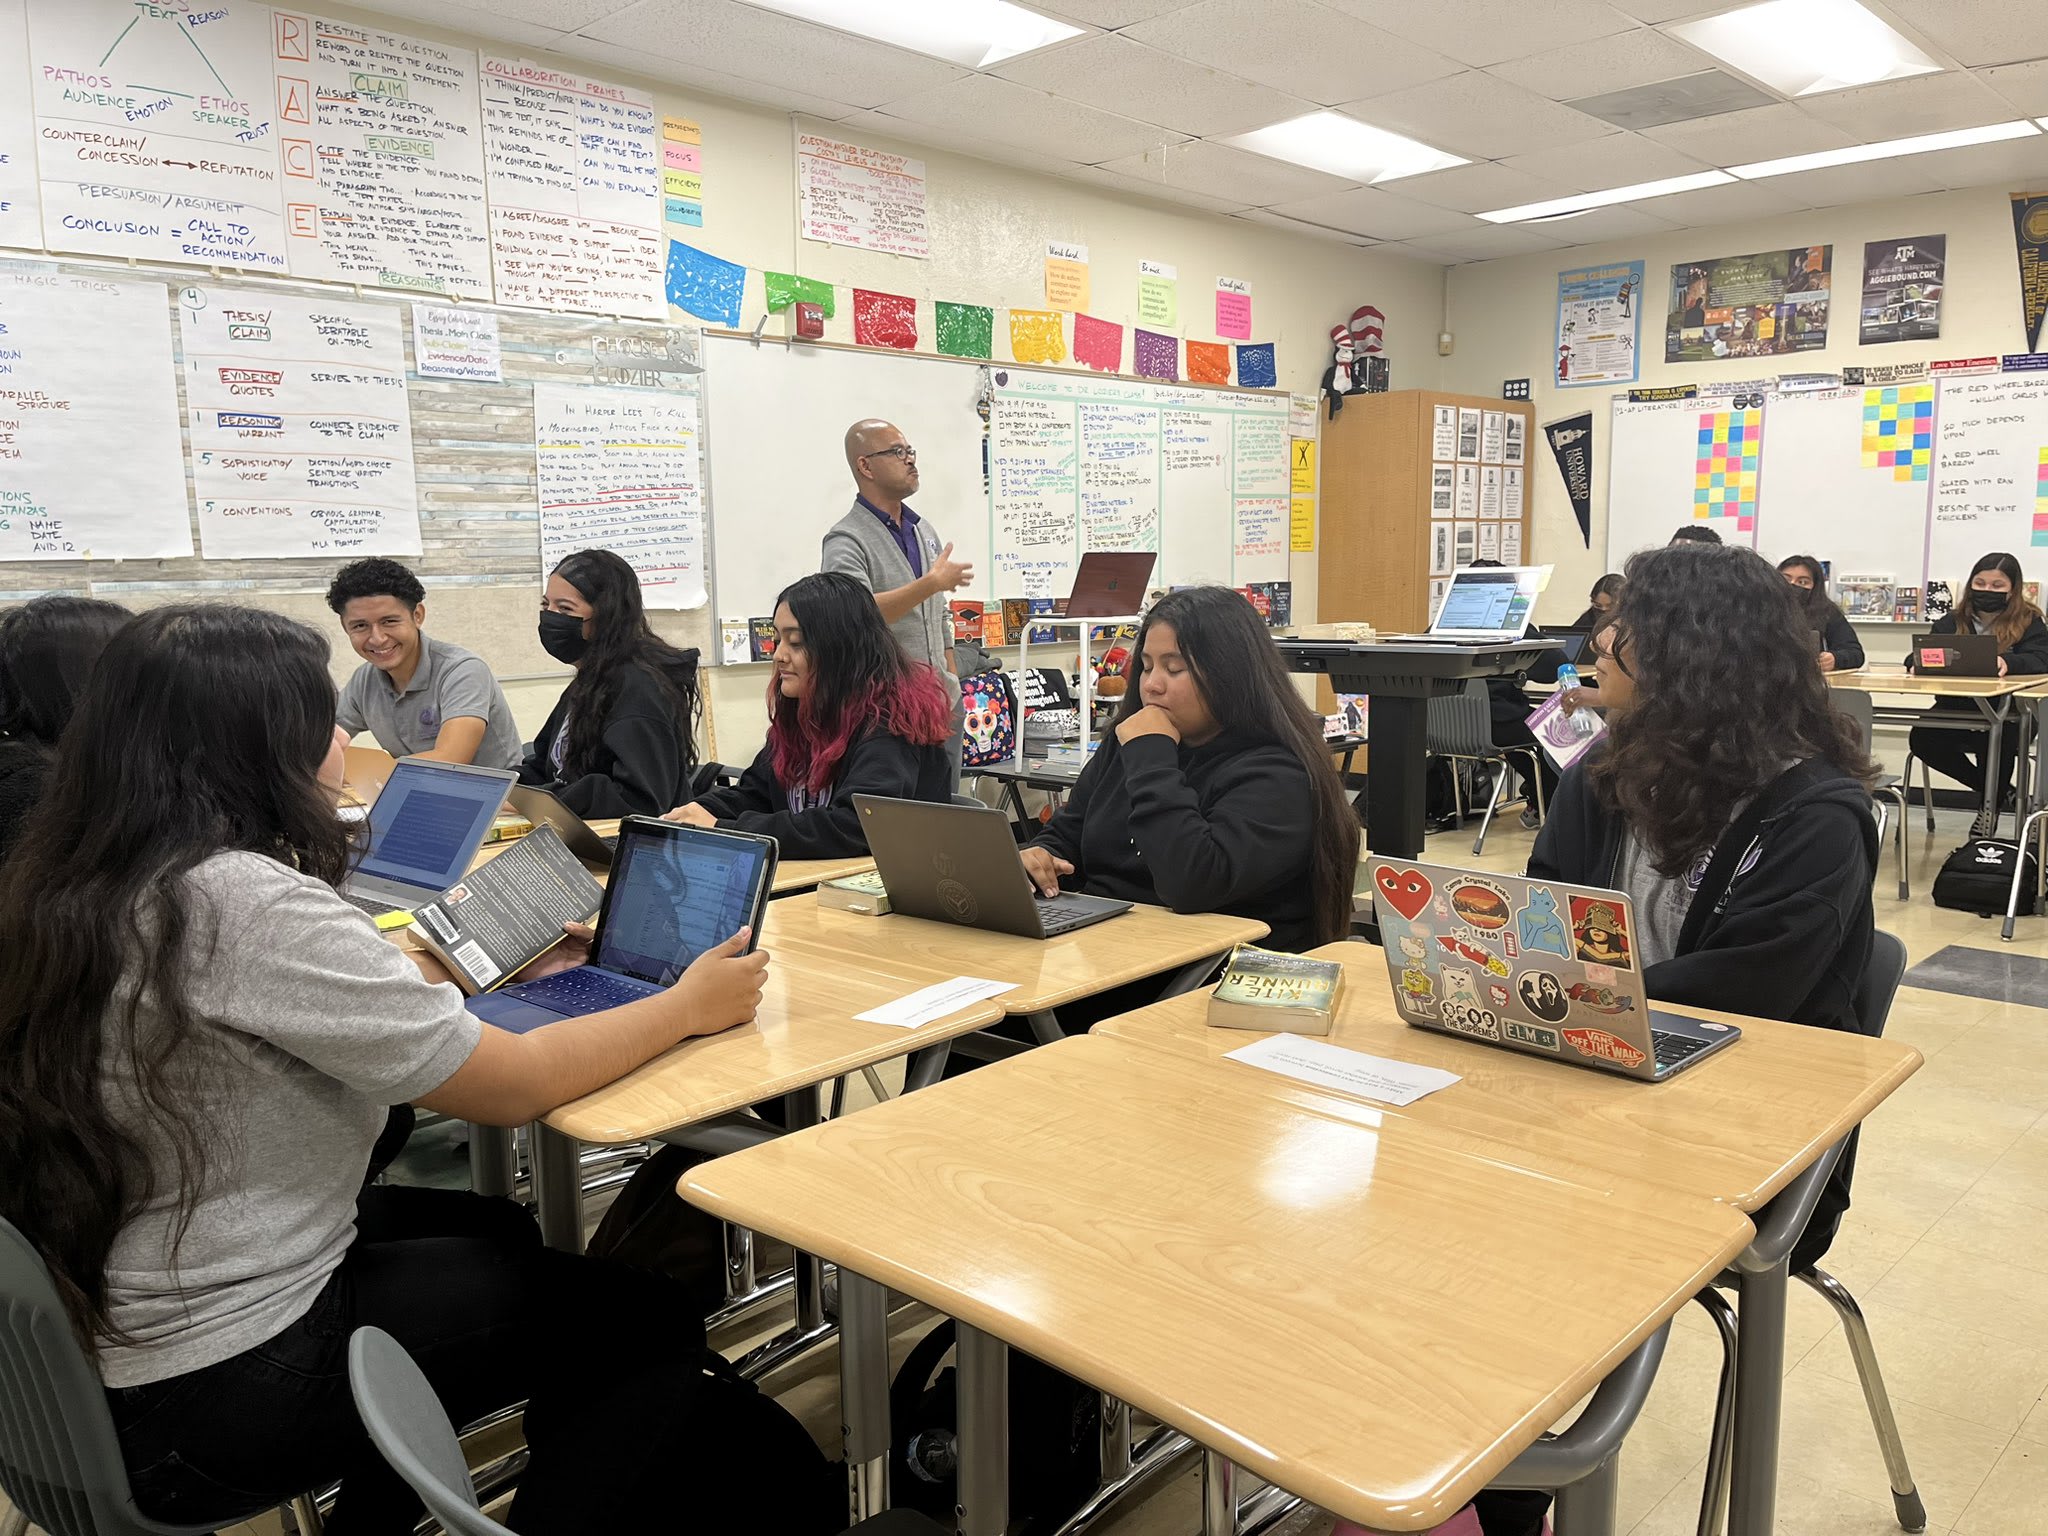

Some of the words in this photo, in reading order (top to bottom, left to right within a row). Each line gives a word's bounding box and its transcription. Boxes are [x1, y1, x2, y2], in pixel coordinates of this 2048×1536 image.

[135, 2, 179, 21] TEXT
[187, 7, 229, 28] REASON
[283, 19, 303, 56] R
[315, 21, 368, 42] RESTATE
[376, 36, 395, 47] THE
[316, 39, 350, 54] REWORD
[354, 49, 365, 58] OR
[369, 50, 402, 64] RESTATE
[406, 57, 421, 68] THE
[426, 61, 464, 78] QUESTION
[319, 52, 335, 63] AND
[340, 57, 361, 68] TURN
[367, 61, 375, 71] IT
[381, 66, 399, 76] INTO
[402, 70, 408, 79] A
[43, 66, 112, 89] PATHOS
[354, 76, 403, 94] CLAIM
[486, 61, 577, 87] COLLABORATION
[586, 83, 625, 100] FRAMES
[63, 89, 136, 109] AUDIENCE
[283, 86, 304, 118] A
[316, 86, 358, 100] ANSWER
[362, 93, 381, 104] THE
[125, 97, 173, 121] EMOTION
[200, 96, 250, 116] ETHOS
[192, 111, 250, 128] SPEAKER
[236, 122, 271, 143] TRUST
[369, 138, 431, 155] EVIDENCE
[288, 146, 305, 170] C
[666, 151, 691, 161] FOCUS
[77, 148, 159, 166] CONCESSION
[200, 161, 274, 180] REFUTATION
[62, 215, 159, 236] CONCLUSION
[187, 219, 221, 232] CALL
[227, 223, 249, 235] TO
[295, 209, 311, 230] E
[182, 245, 284, 265] RECOMMENDATION
[1141, 262, 1149, 272] Be
[1904, 263, 1940, 271] HAPPENING
[382, 273, 443, 289] REASONING
[1870, 270, 1936, 285] AGGIEBOUND.COM
[15, 275, 59, 287] MAGIC
[71, 279, 120, 296] TRICKS
[223, 310, 271, 323] THESIS/
[309, 314, 352, 326] SPECIFIC
[231, 327, 268, 338] CLAIM
[317, 326, 369, 337] DEBATABLE
[428, 352, 488, 364] Evidence/Data
[1931, 361, 1948, 369] Love
[1950, 359, 1965, 367] Your
[1966, 357, 1996, 366] Enemies
[421, 363, 496, 376] Reasoning/Warrant
[311, 373, 350, 384] SERVES
[354, 375, 369, 384] THE
[373, 376, 403, 388] THESIS
[1018, 381, 1057, 391] WELCOME
[230, 384, 275, 397] QUOTES
[2012, 392, 2037, 400] CARLOS
[565, 405, 575, 415] IN
[586, 405, 616, 415] HARPER
[668, 408, 686, 418] KILL
[1638, 403, 1678, 413] LITERATURE
[310, 421, 354, 430] CONNECTS
[357, 422, 399, 432] EVIDENCE
[1962, 420, 1981, 428] MUCH
[1987, 416, 2025, 424] DEPENDS
[237, 430, 285, 438] WARRANT
[321, 429, 332, 437] TO
[335, 429, 352, 437] THE
[358, 431, 384, 440] CLAIM
[1941, 460, 1975, 468] BARROW
[237, 472, 267, 481] VOICE
[308, 469, 350, 477] SENTENCE
[1566, 450, 1580, 500] UNIVERSITY
[1574, 447, 1589, 499] HOWARD
[1940, 479, 1969, 487] GLAZED
[223, 507, 292, 516] CONVENTIONS
[30, 520, 62, 530] NAME
[31, 530, 62, 540] DATE
[34, 541, 58, 552] AVID
[62, 541, 76, 551] 12
[1975, 856, 2002, 864] adidas
[1445, 879, 1462, 891] Camp
[1465, 877, 1491, 886] Crystal
[1495, 886, 1510, 900] Lake
[1230, 975, 1329, 991] RUNNER
[1245, 987, 1301, 1000] KITE
[1446, 1019, 1459, 1030] THE
[1460, 1024, 1498, 1039] SUPREMES
[1506, 1024, 1537, 1042] ELM
[1543, 1034, 1550, 1043] st
[1586, 1031, 1614, 1046] VANS
[1590, 1040, 1611, 1055] THE
